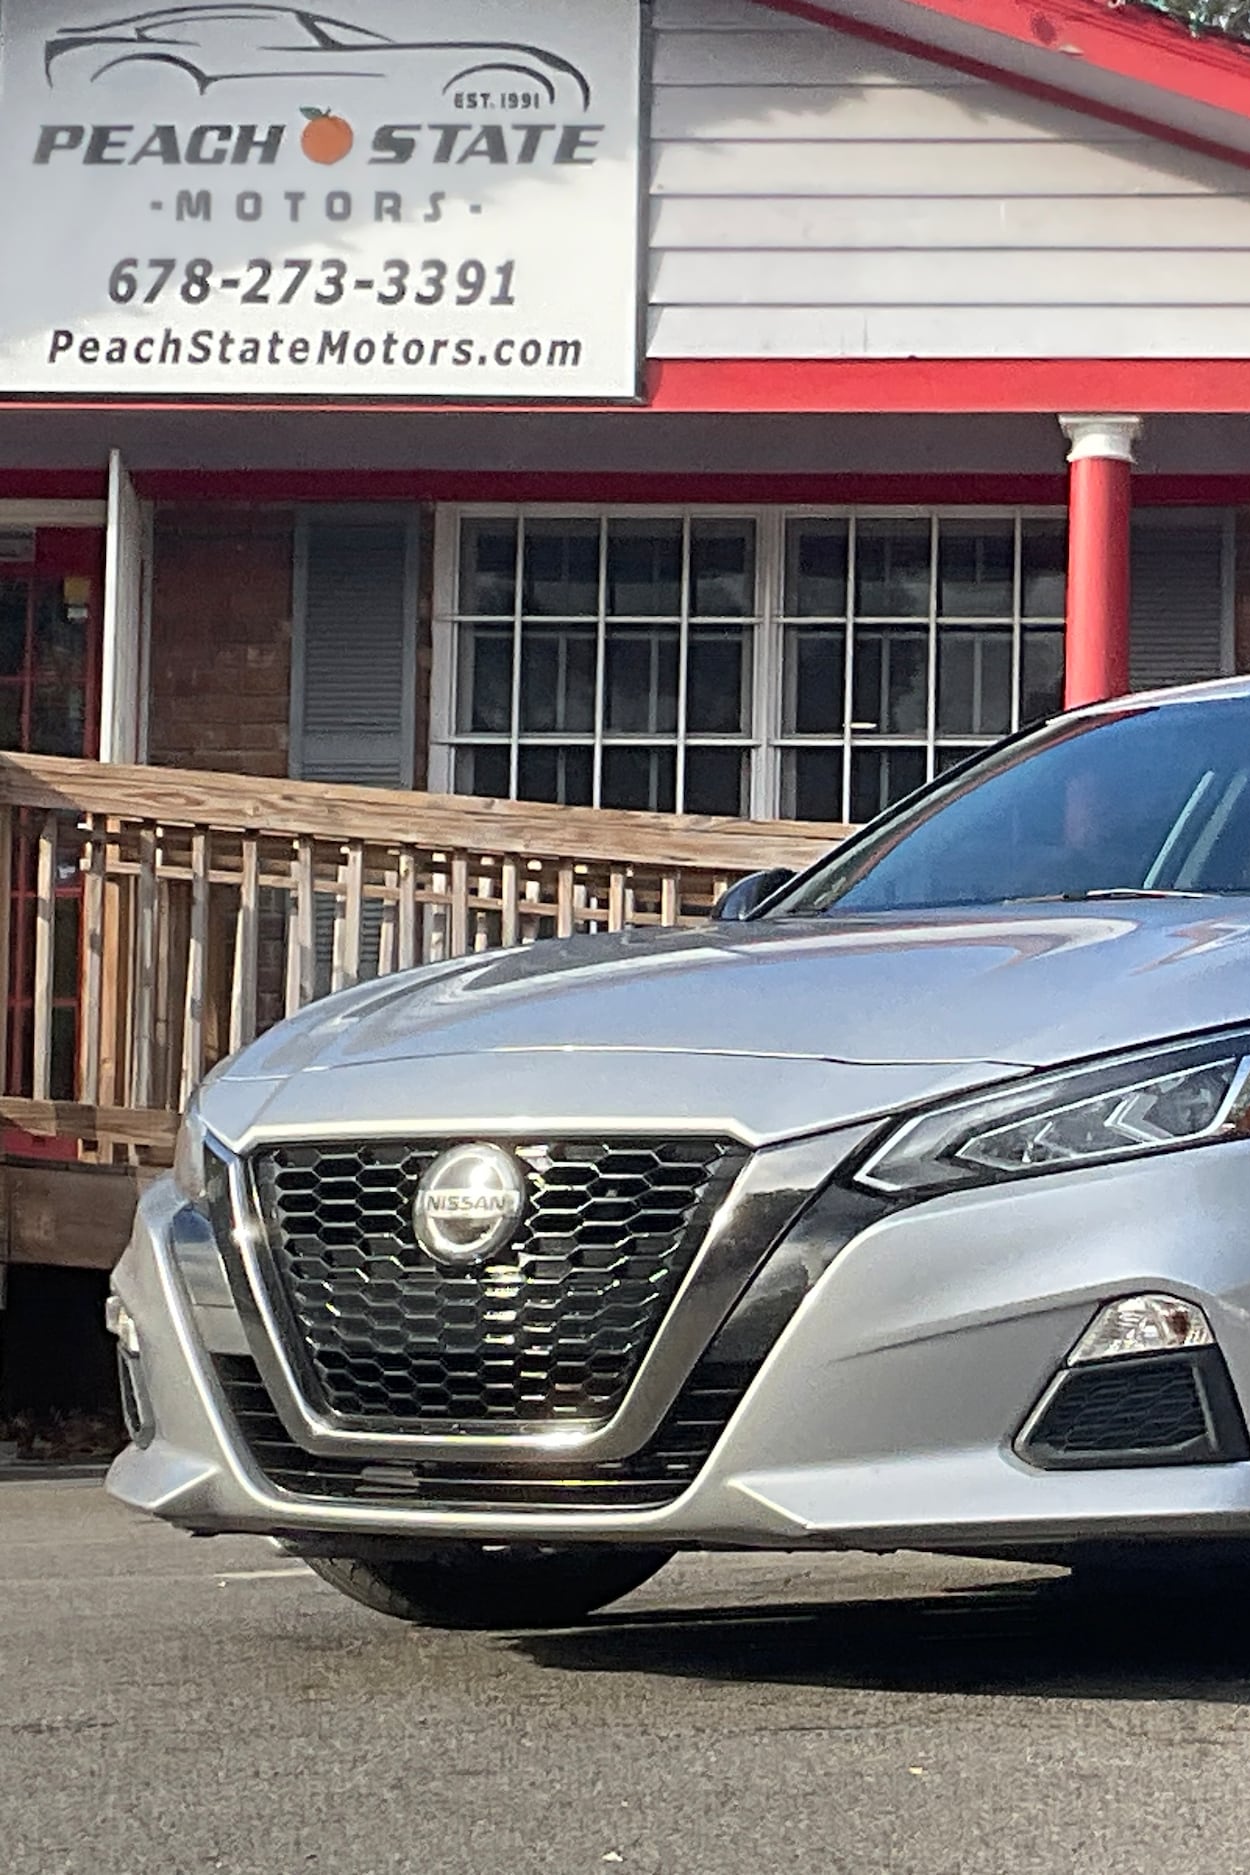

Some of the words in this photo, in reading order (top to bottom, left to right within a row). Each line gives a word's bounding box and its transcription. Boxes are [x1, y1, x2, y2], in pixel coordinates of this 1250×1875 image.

[500, 92, 540, 109] 1991
[32, 124, 286, 166] PEACH
[367, 124, 605, 165] STATE
[107, 258, 517, 306] 678-273-3391
[47, 329, 583, 368] PeachStateMotors.com
[427, 1195, 506, 1211] NISSAN
